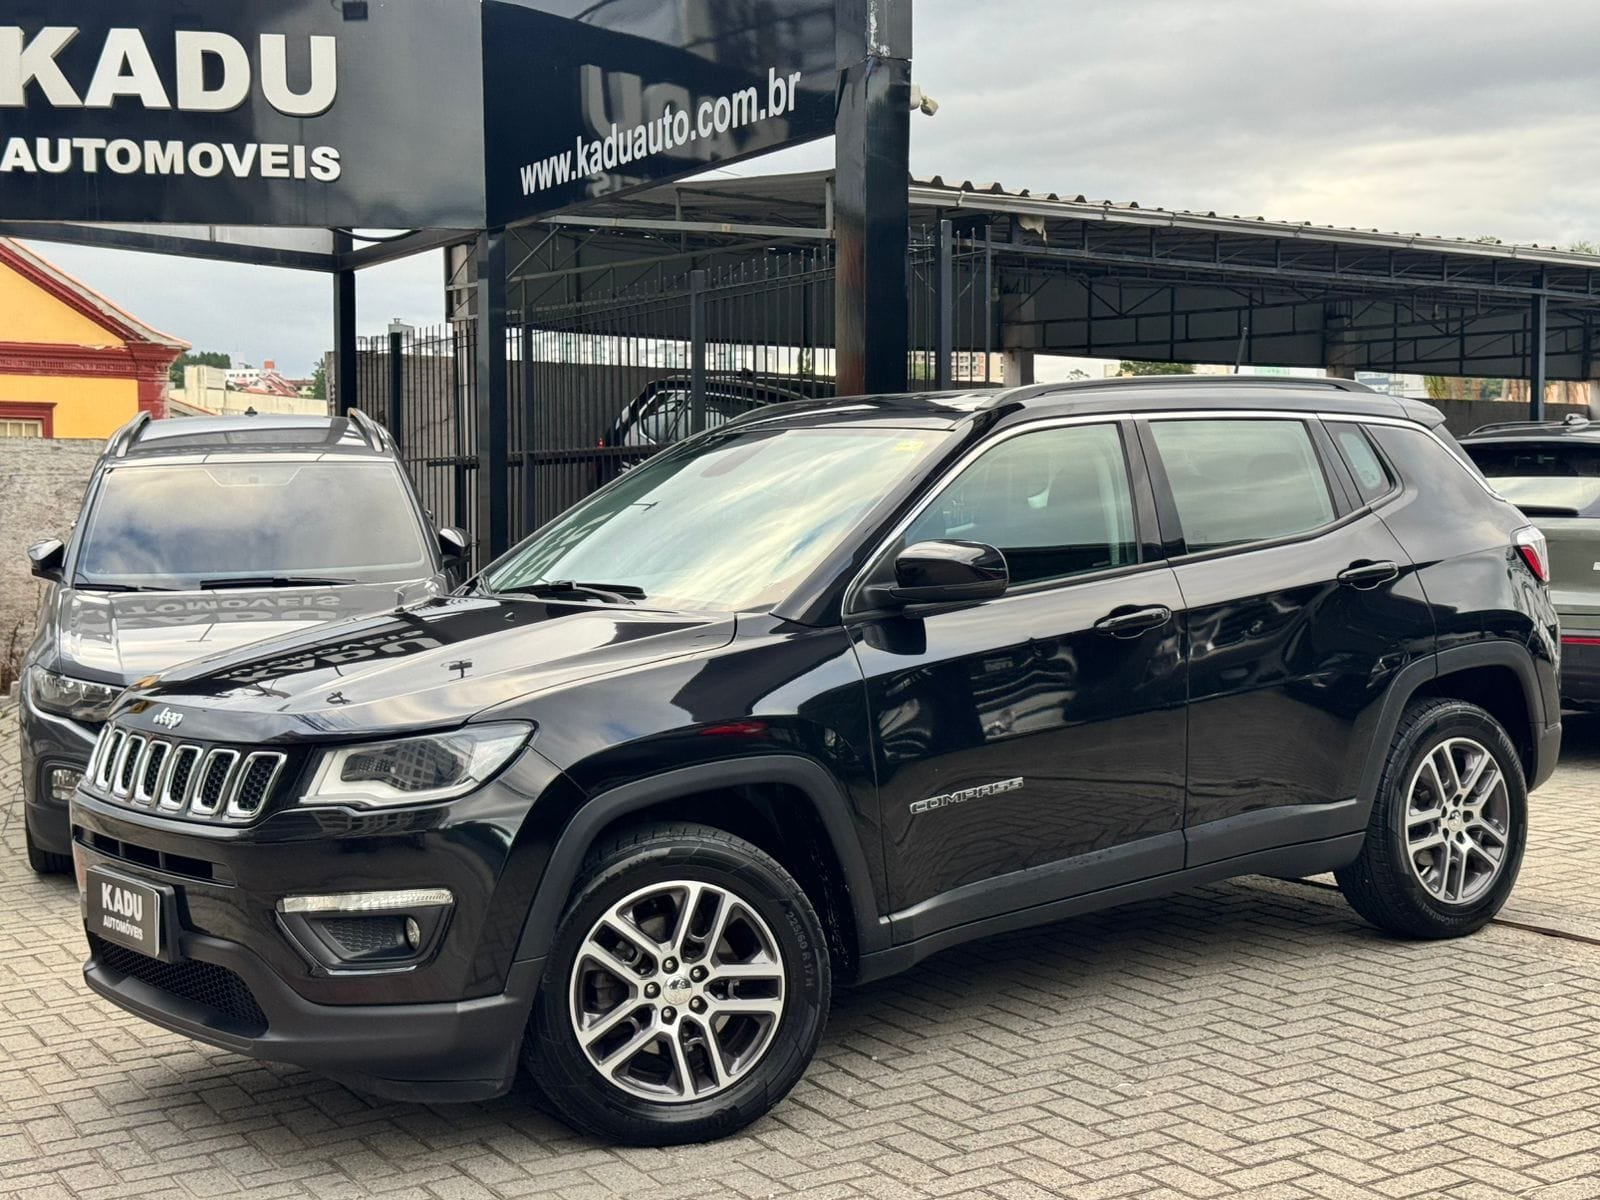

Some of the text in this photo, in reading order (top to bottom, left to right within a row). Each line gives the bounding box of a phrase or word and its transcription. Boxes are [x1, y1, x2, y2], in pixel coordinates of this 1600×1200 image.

[0, 26, 337, 117] KADU
[520, 67, 801, 195] www.kaduauto.com.br
[0, 137, 341, 182] AUTOMOVEIS
[909, 776, 1024, 814] COMPASS
[102, 882, 142, 922] KADU
[103, 914, 143, 940] AUTOMÓVEIS
